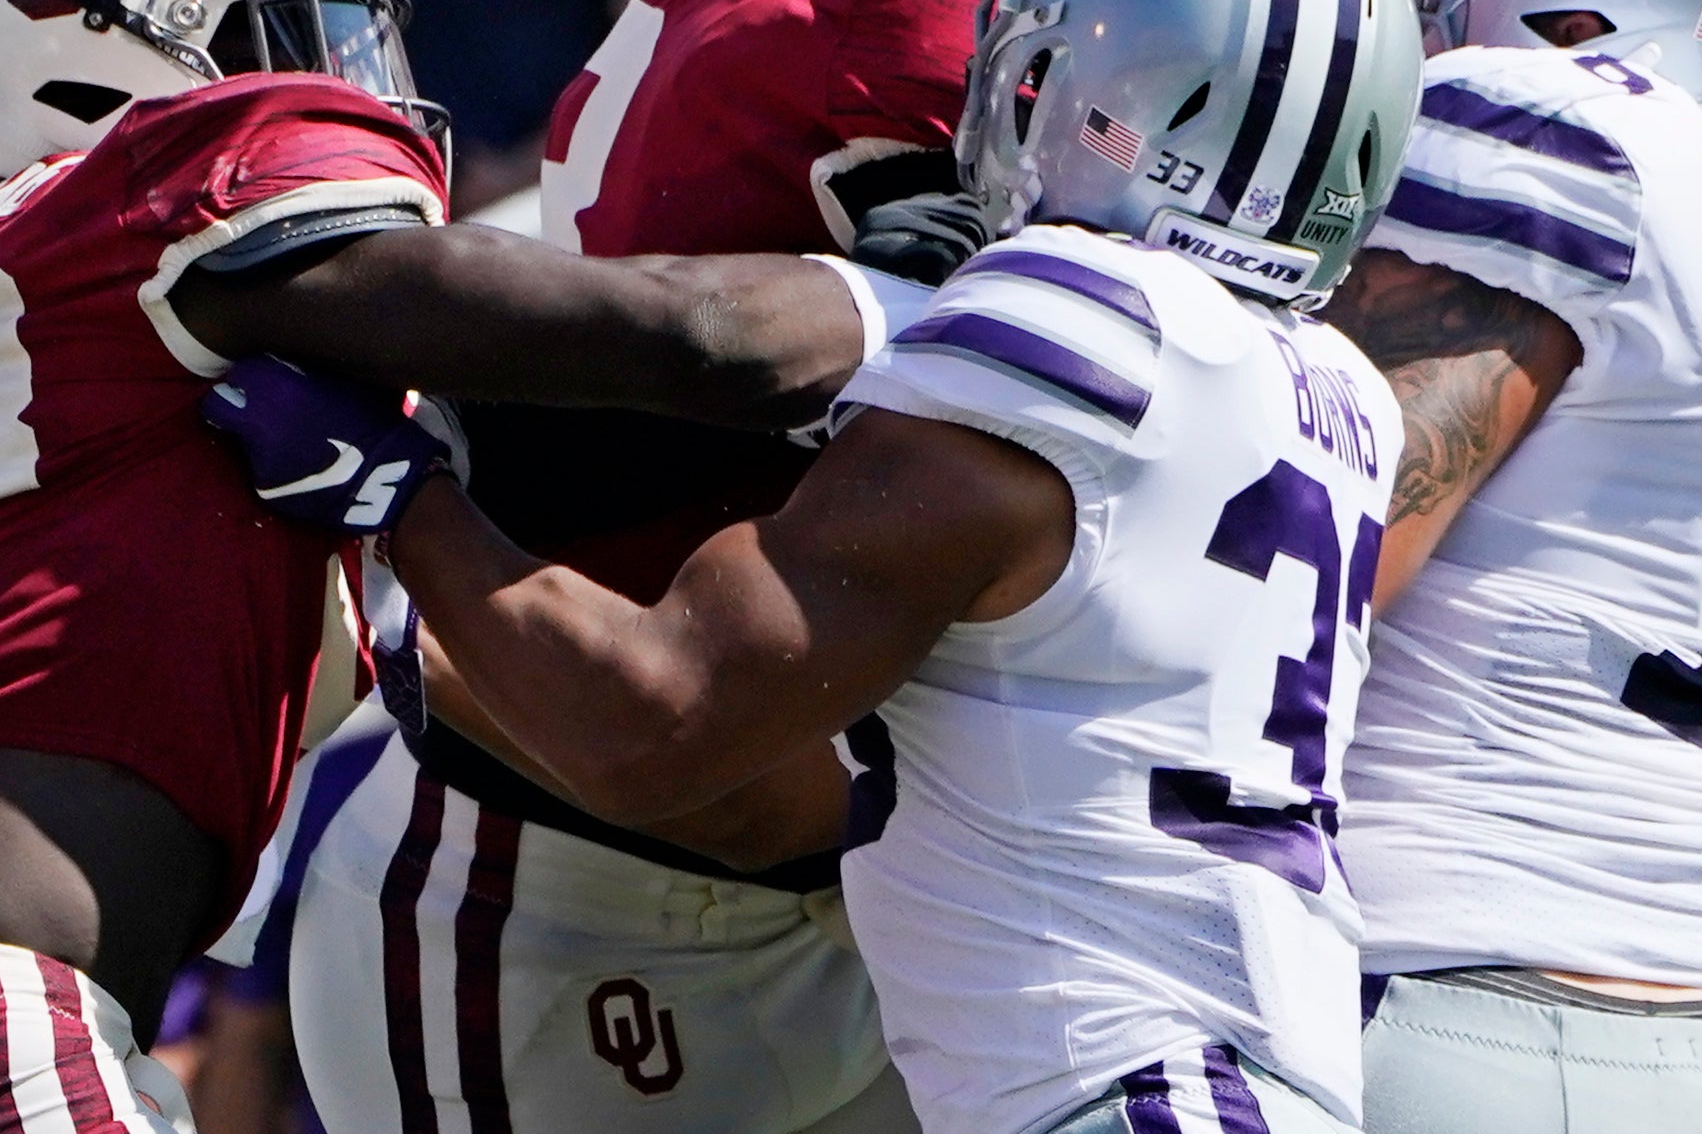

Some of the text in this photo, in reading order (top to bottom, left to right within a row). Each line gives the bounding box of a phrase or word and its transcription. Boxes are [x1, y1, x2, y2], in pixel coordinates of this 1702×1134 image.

[1146, 149, 1205, 197] 33
[1166, 227, 1306, 284] WILDCATS
[1299, 220, 1349, 246] UNITY
[587, 978, 684, 1097] OU
